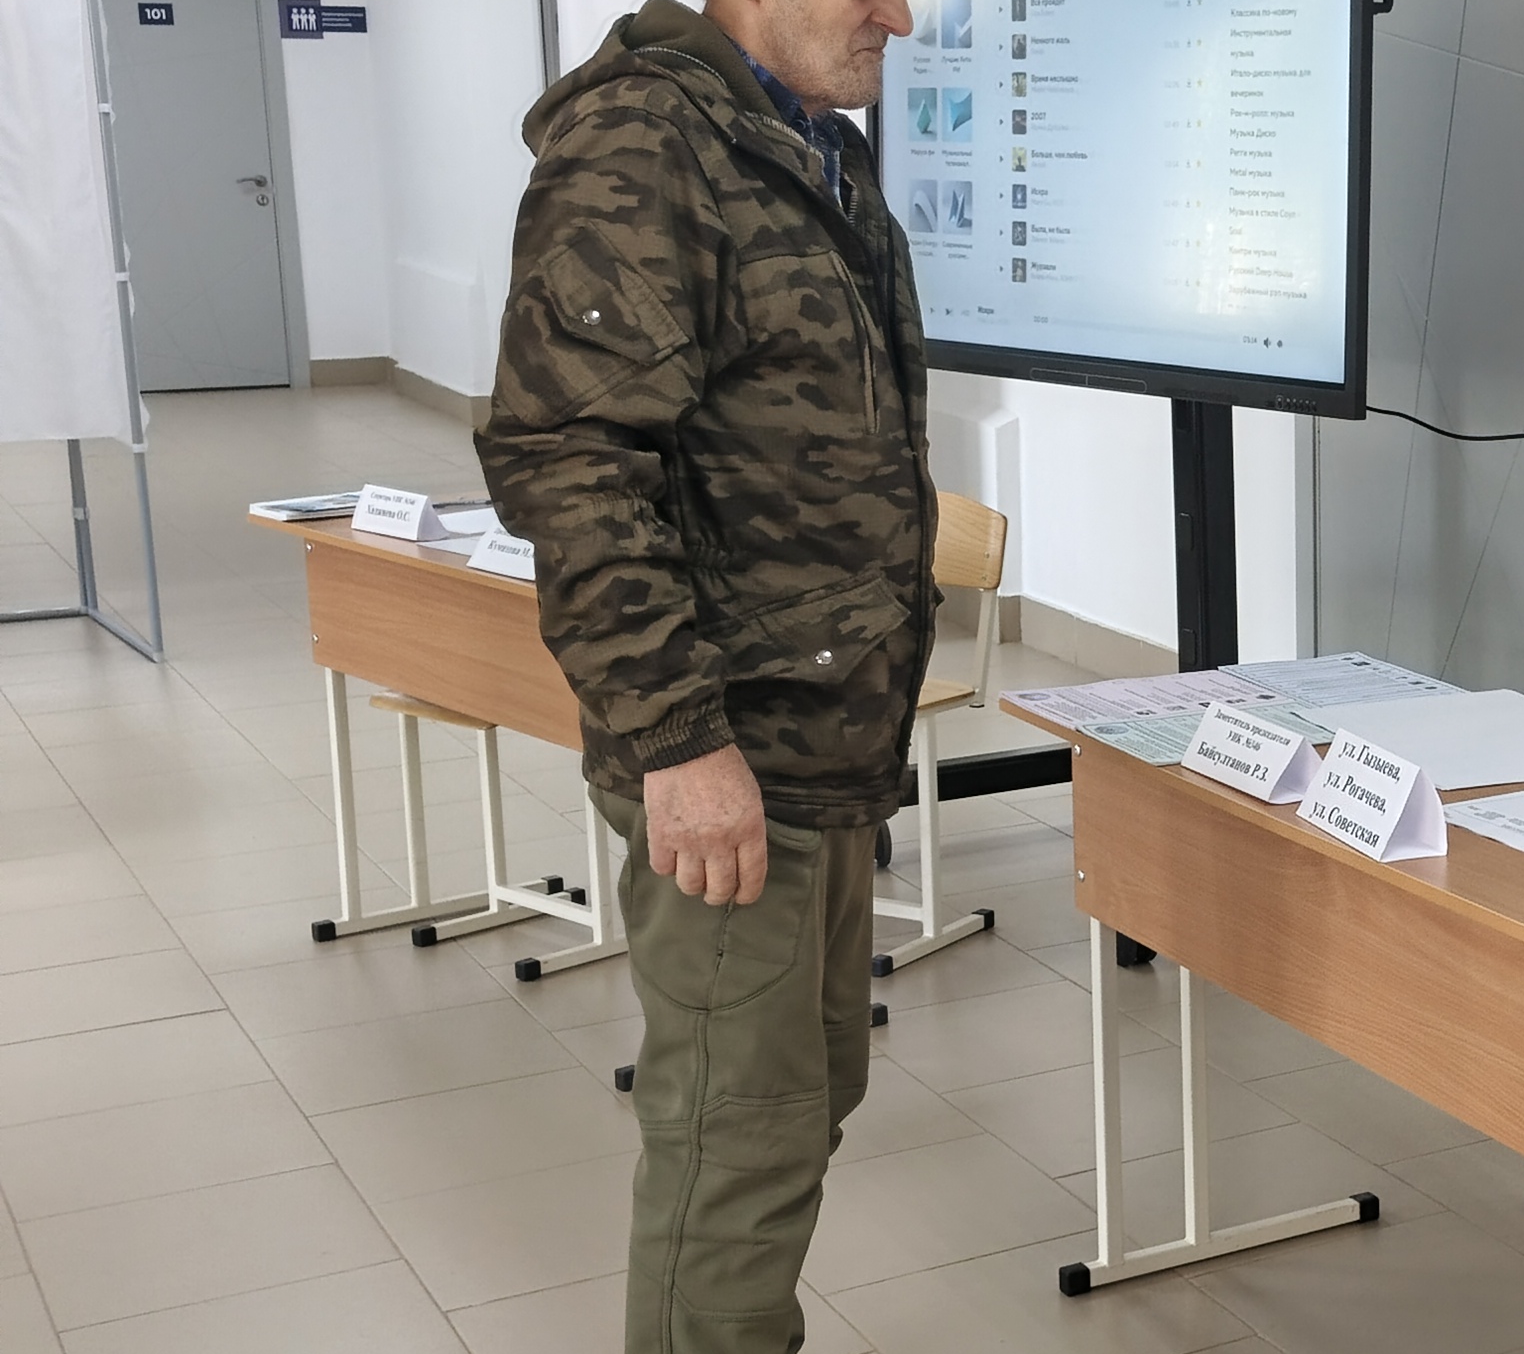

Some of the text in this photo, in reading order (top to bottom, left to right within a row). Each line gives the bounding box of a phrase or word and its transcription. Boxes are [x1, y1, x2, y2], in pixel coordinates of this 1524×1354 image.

[145, 8, 166, 20] 101
[1197, 741, 1251, 774] Байсултанов
[1338, 741, 1401, 784] ул. Гызыева,
[1323, 771, 1387, 815] ул. Рогачева,
[1308, 801, 1380, 848] ул. Советская
